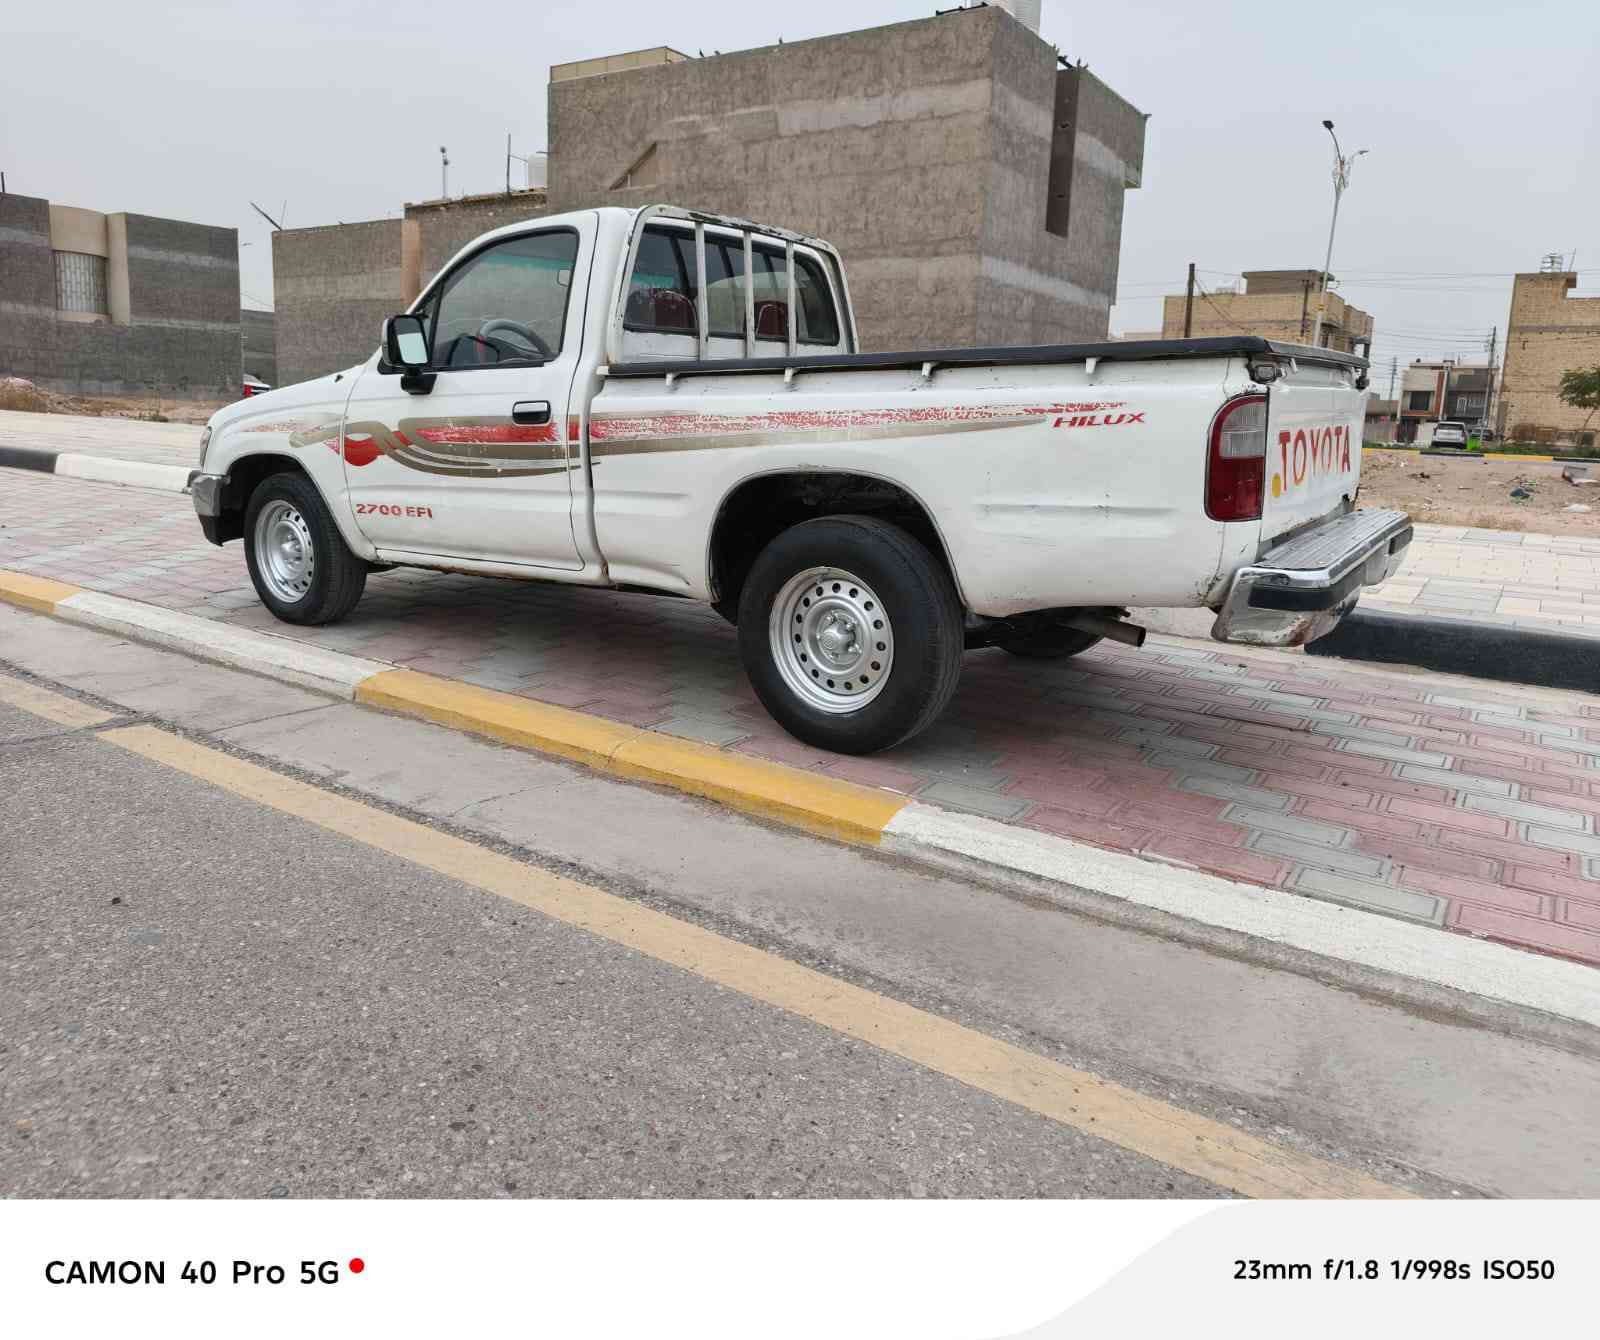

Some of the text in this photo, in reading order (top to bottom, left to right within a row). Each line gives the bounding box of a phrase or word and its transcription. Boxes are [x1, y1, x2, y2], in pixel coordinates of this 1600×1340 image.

[1053, 412, 1146, 428] HILUX
[1278, 424, 1351, 492] TOYOTA
[355, 503, 433, 519] 2700 EFI
